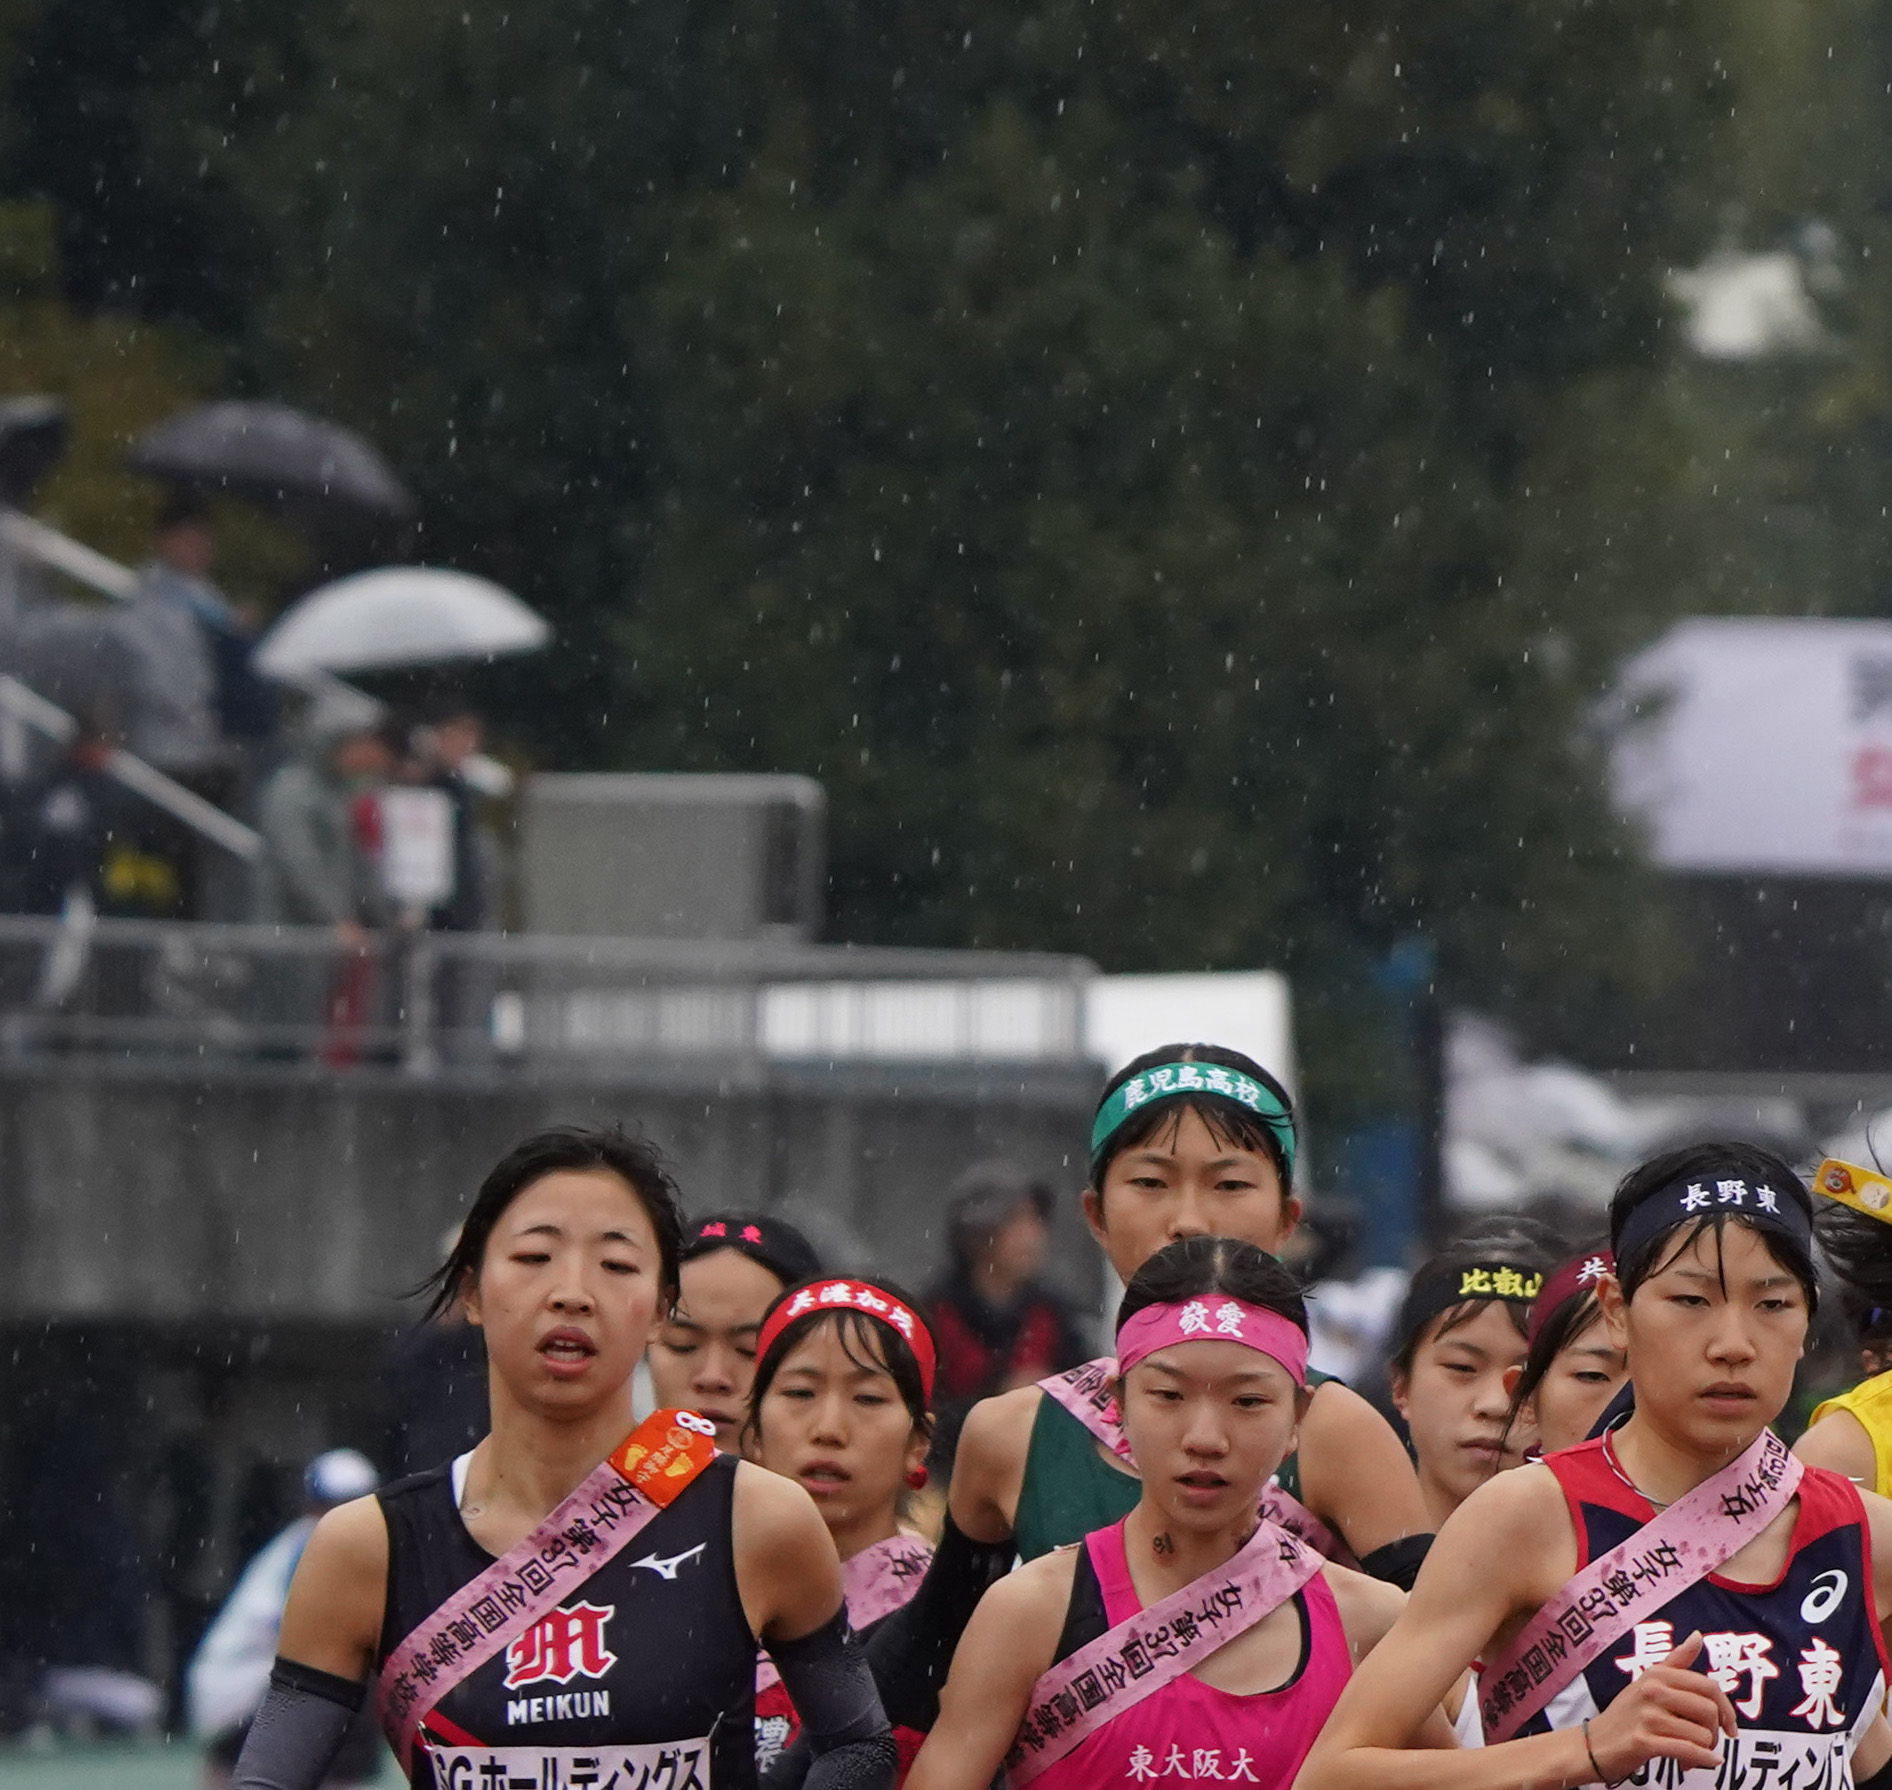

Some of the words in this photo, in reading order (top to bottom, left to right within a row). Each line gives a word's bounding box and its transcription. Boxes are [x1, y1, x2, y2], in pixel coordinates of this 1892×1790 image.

[1124, 1065, 1261, 1111] 鹿児島高校
[1680, 1179, 1781, 1215] 長野東
[1459, 1266, 1543, 1298] 比叡山
[1179, 1300, 1247, 1337] 敬愛
[1613, 1619, 1847, 1731] 長野東
[507, 1690, 611, 1725] MEIKUN
[1125, 1743, 1261, 1784] 東大阪大
